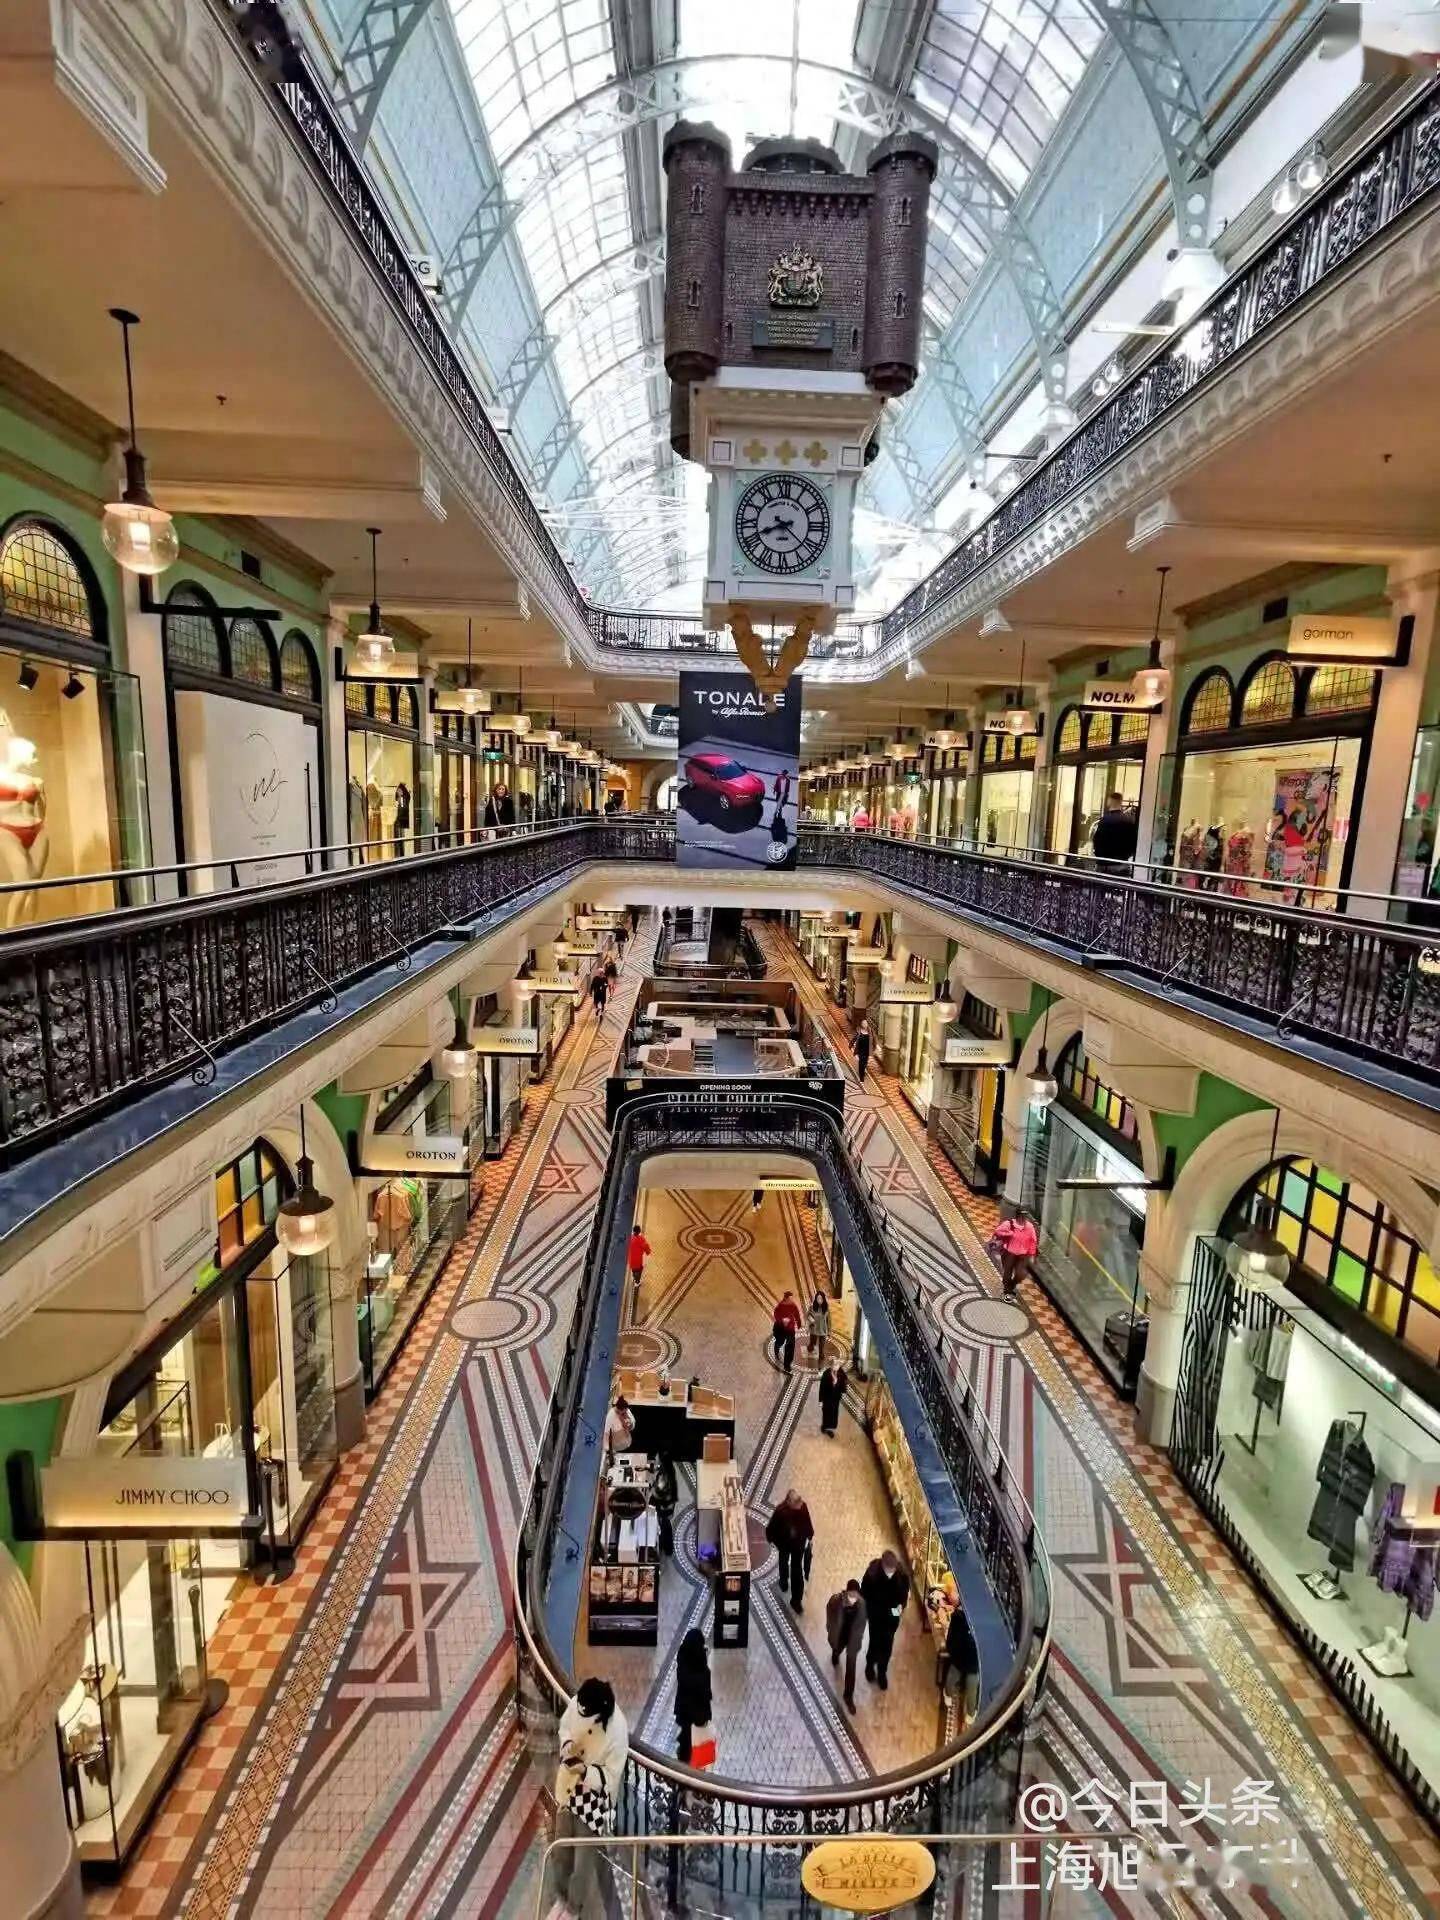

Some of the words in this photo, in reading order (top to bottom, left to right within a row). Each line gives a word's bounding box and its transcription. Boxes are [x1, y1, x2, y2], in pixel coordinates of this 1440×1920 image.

[1303, 628, 1354, 641] gorman
[693, 690, 786, 707] TONALE
[822, 925, 840, 933] UGG
[498, 1035, 535, 1046] OROTON
[405, 1150, 457, 1161] OROTON
[115, 1489, 166, 1505] JIMMY
[170, 1489, 230, 1505] CHOO
